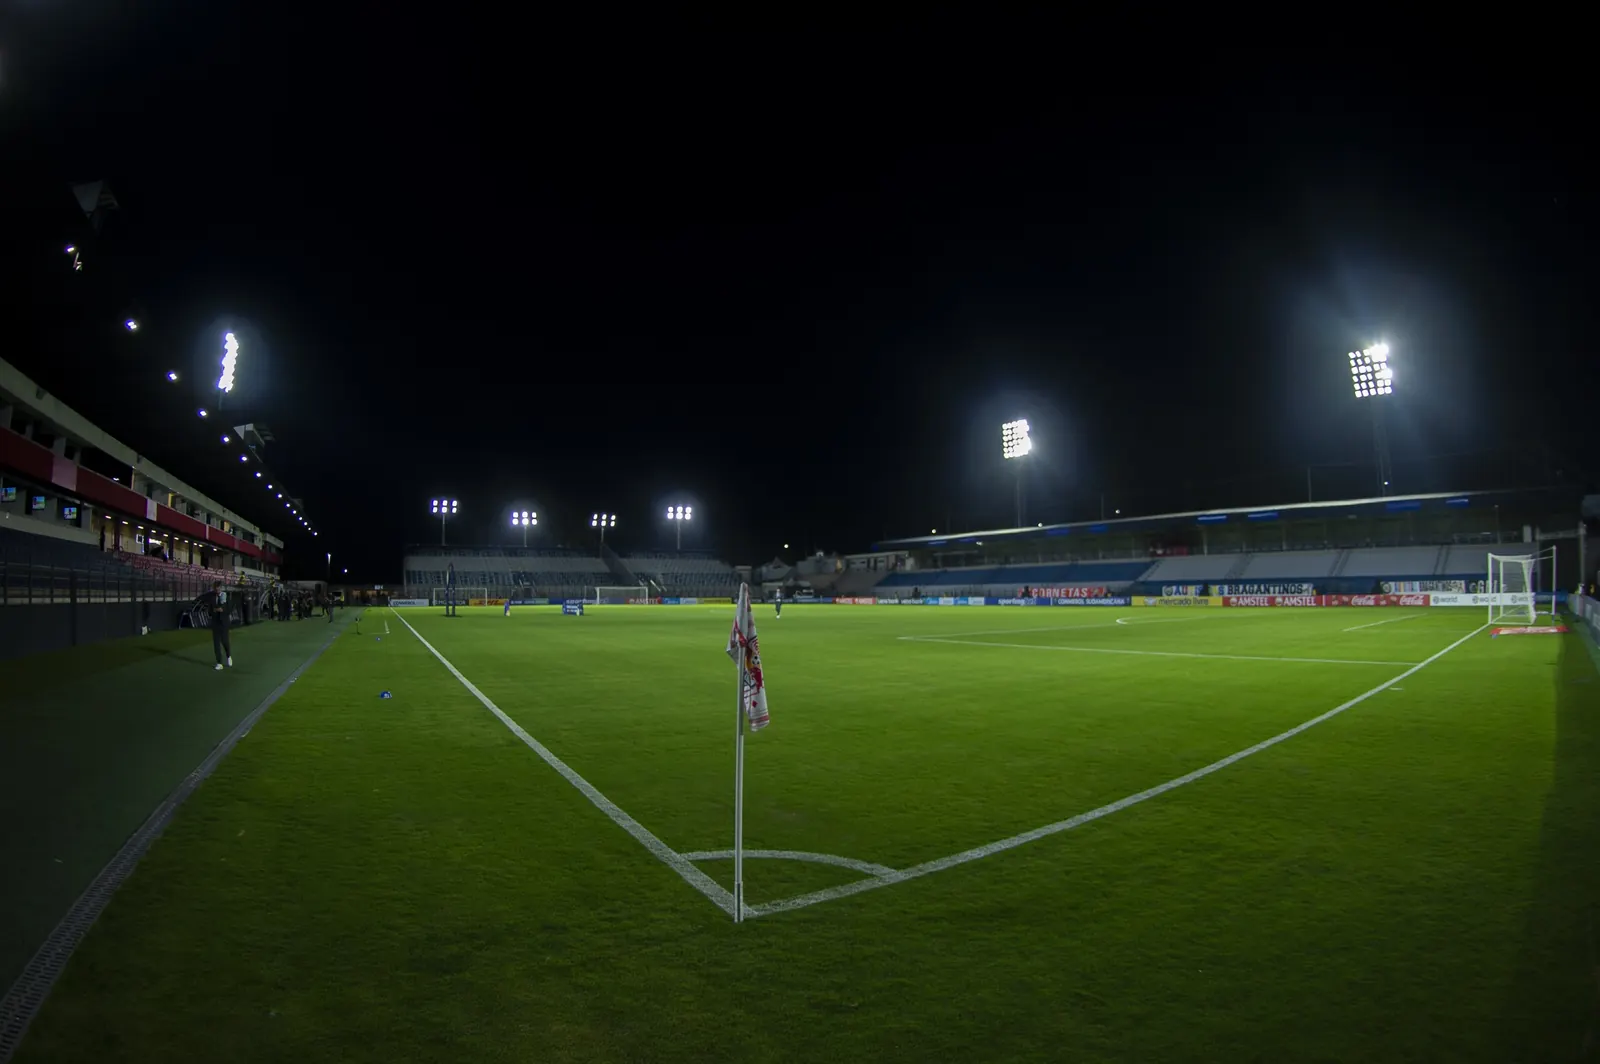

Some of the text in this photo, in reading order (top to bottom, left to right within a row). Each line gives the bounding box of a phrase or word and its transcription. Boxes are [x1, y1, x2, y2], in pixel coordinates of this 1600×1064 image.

[1031, 587, 1088, 598] CORNETAS
[1158, 597, 1192, 606] mercado
[1238, 596, 1269, 606] AMSTEL
[1284, 596, 1316, 606] AMSTEL
